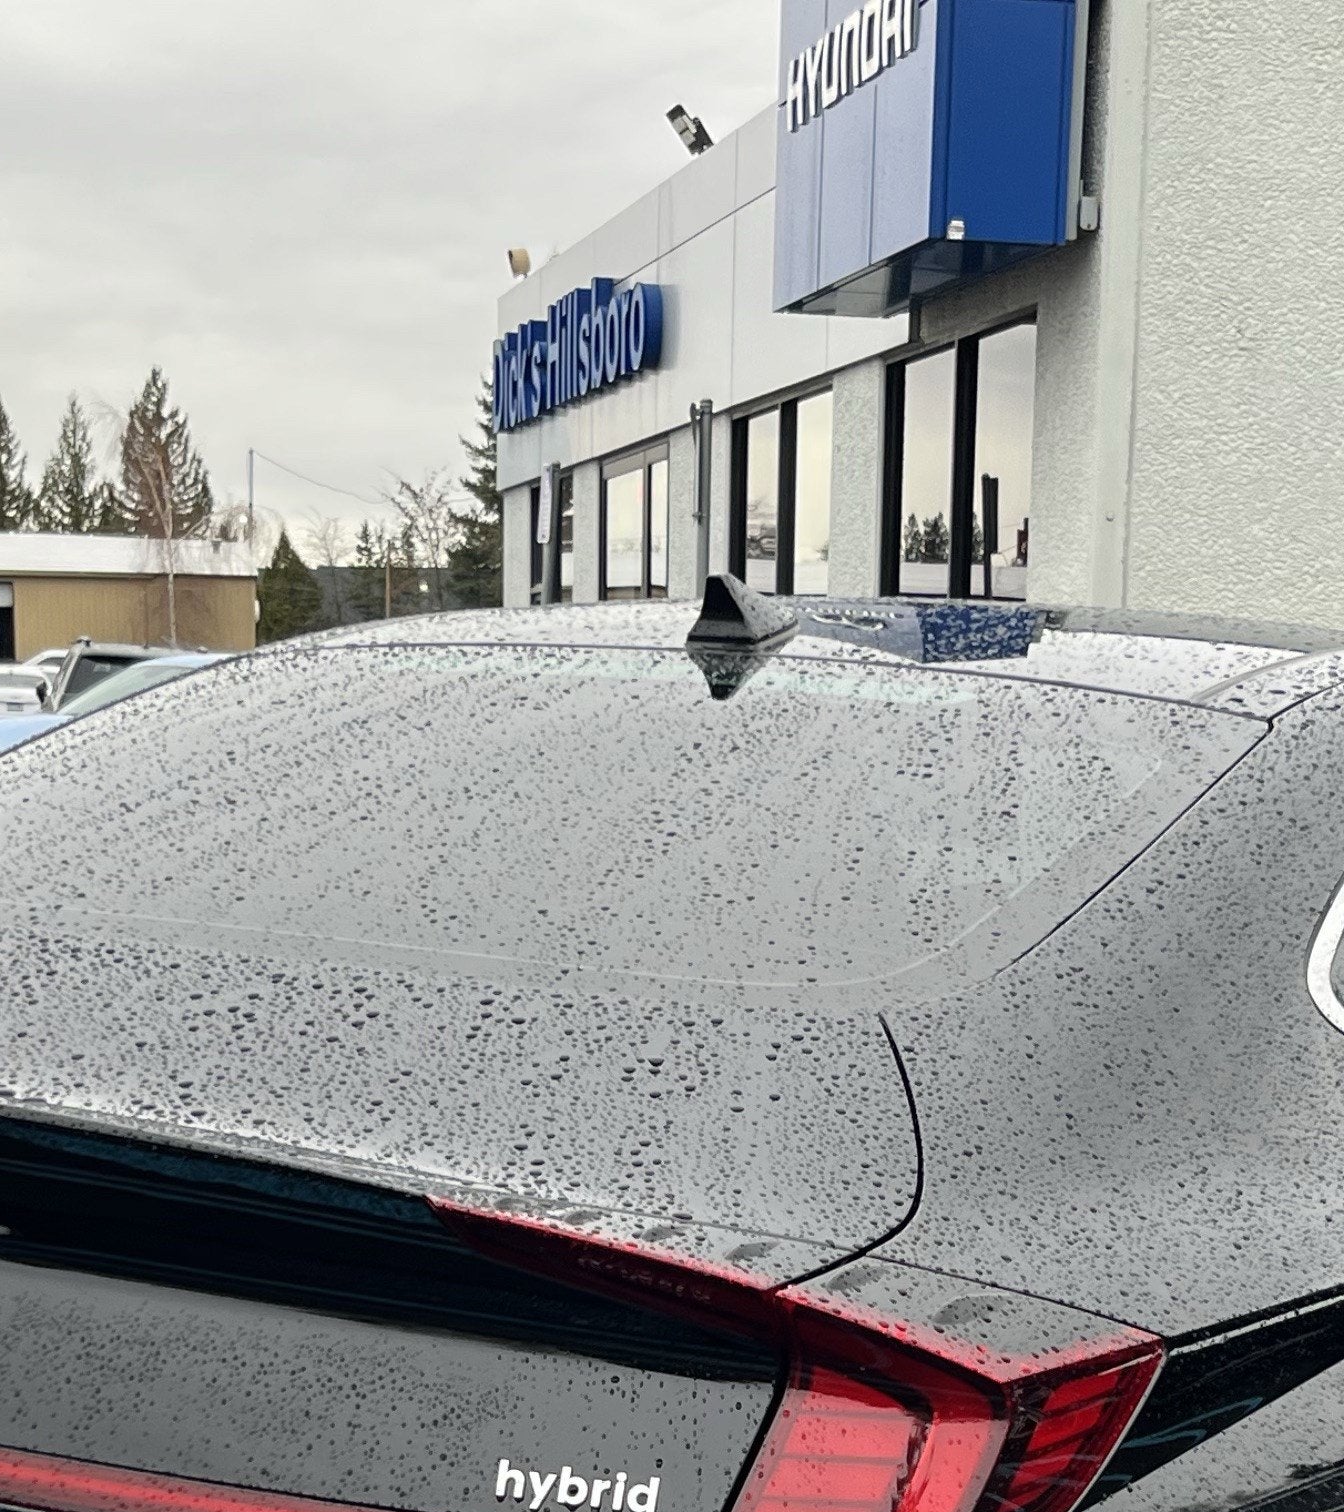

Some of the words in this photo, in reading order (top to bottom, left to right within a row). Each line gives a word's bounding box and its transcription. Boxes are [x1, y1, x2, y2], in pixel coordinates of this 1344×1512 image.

[786, 0, 914, 133] HYUNDAI
[492, 319, 541, 434] Dick's
[546, 277, 646, 410] Hillsboro
